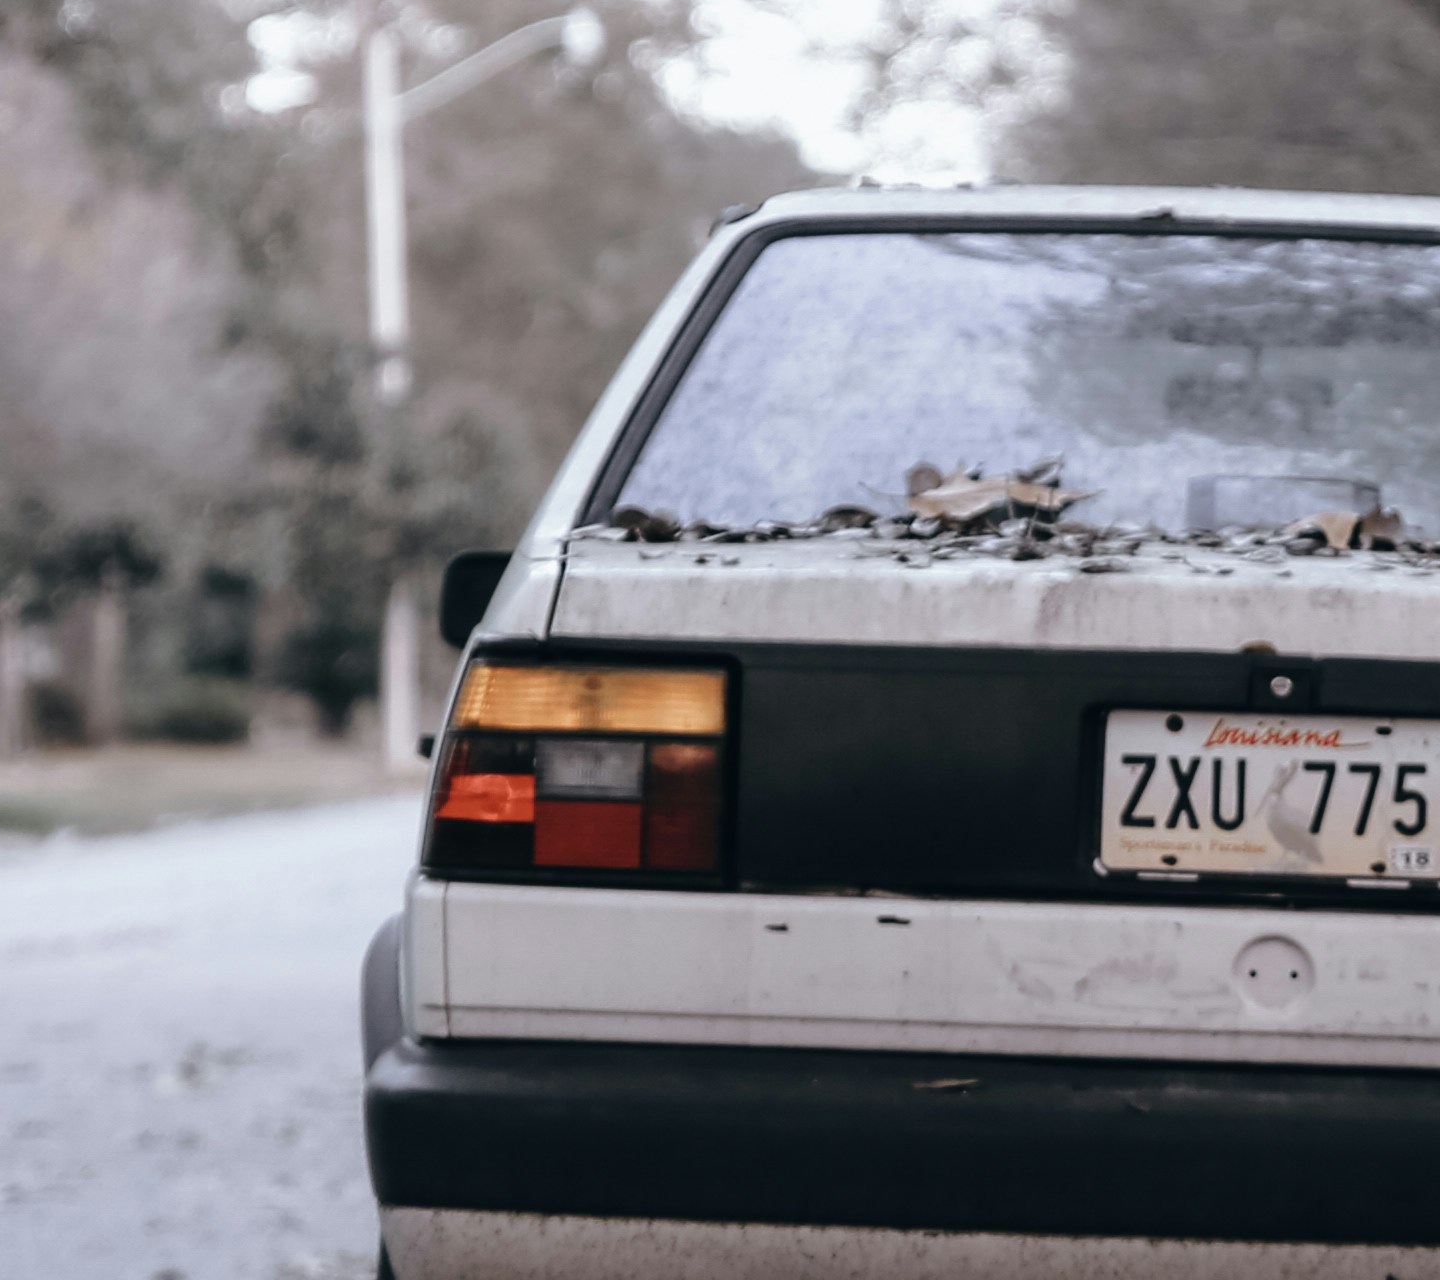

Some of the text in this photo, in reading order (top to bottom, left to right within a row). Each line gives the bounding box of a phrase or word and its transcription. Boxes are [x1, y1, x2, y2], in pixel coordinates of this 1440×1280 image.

[1201, 717, 1371, 751] Louisiana
[1120, 754, 1428, 837] ZXU 775
